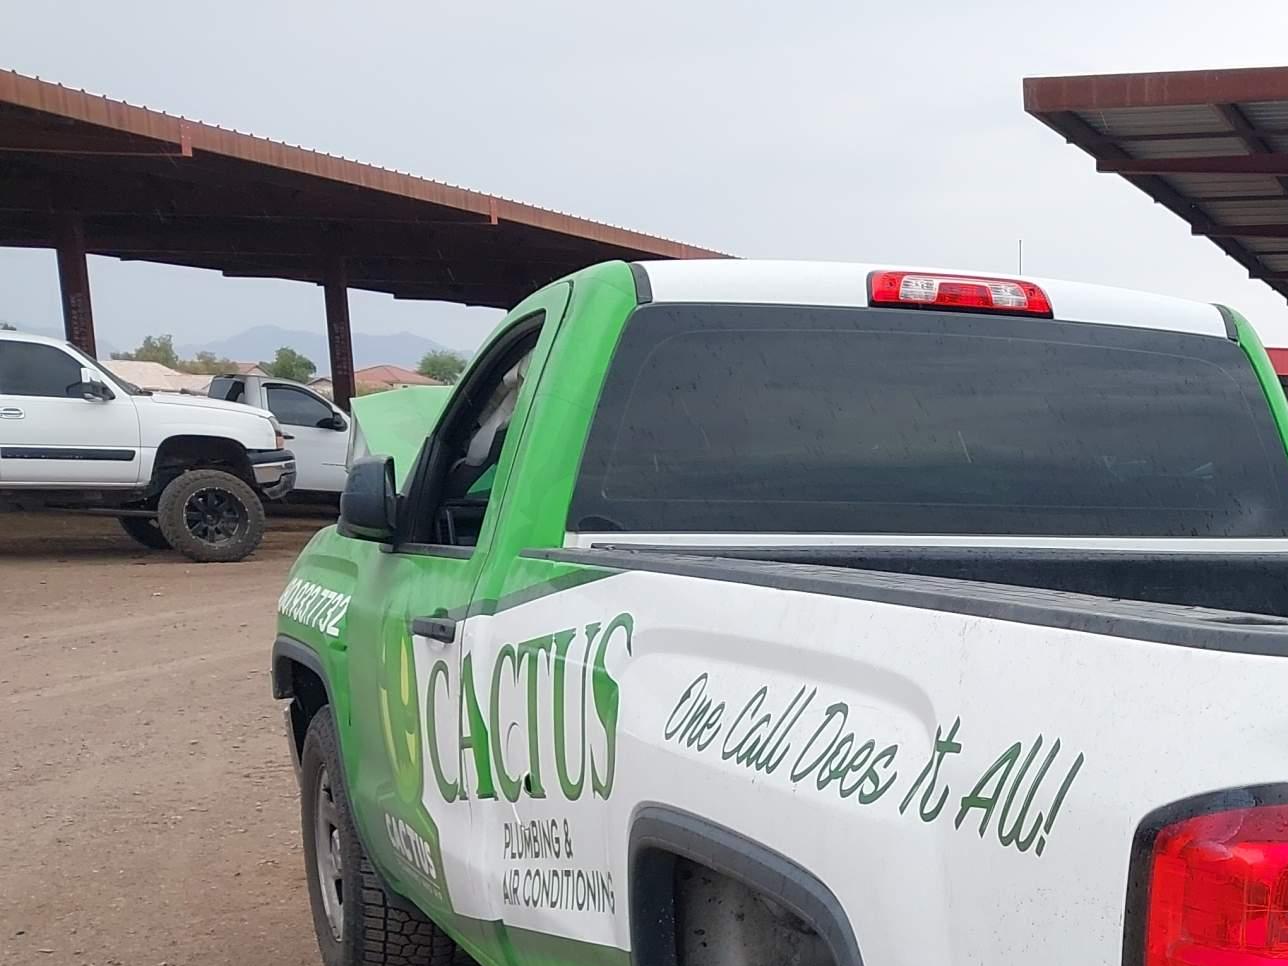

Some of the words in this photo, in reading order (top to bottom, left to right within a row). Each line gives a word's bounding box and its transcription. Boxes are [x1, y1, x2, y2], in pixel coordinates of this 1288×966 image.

[426, 612, 635, 804] CACTUS
[664, 672, 726, 752] One
[721, 684, 818, 775] Call
[790, 702, 899, 805] Does
[899, 716, 962, 823] It
[954, 733, 1085, 858] All!
[502, 868, 521, 906] AIR
[522, 868, 616, 915] CONDITIONING
[503, 818, 561, 860] PLUMBING
[563, 817, 574, 859] &
